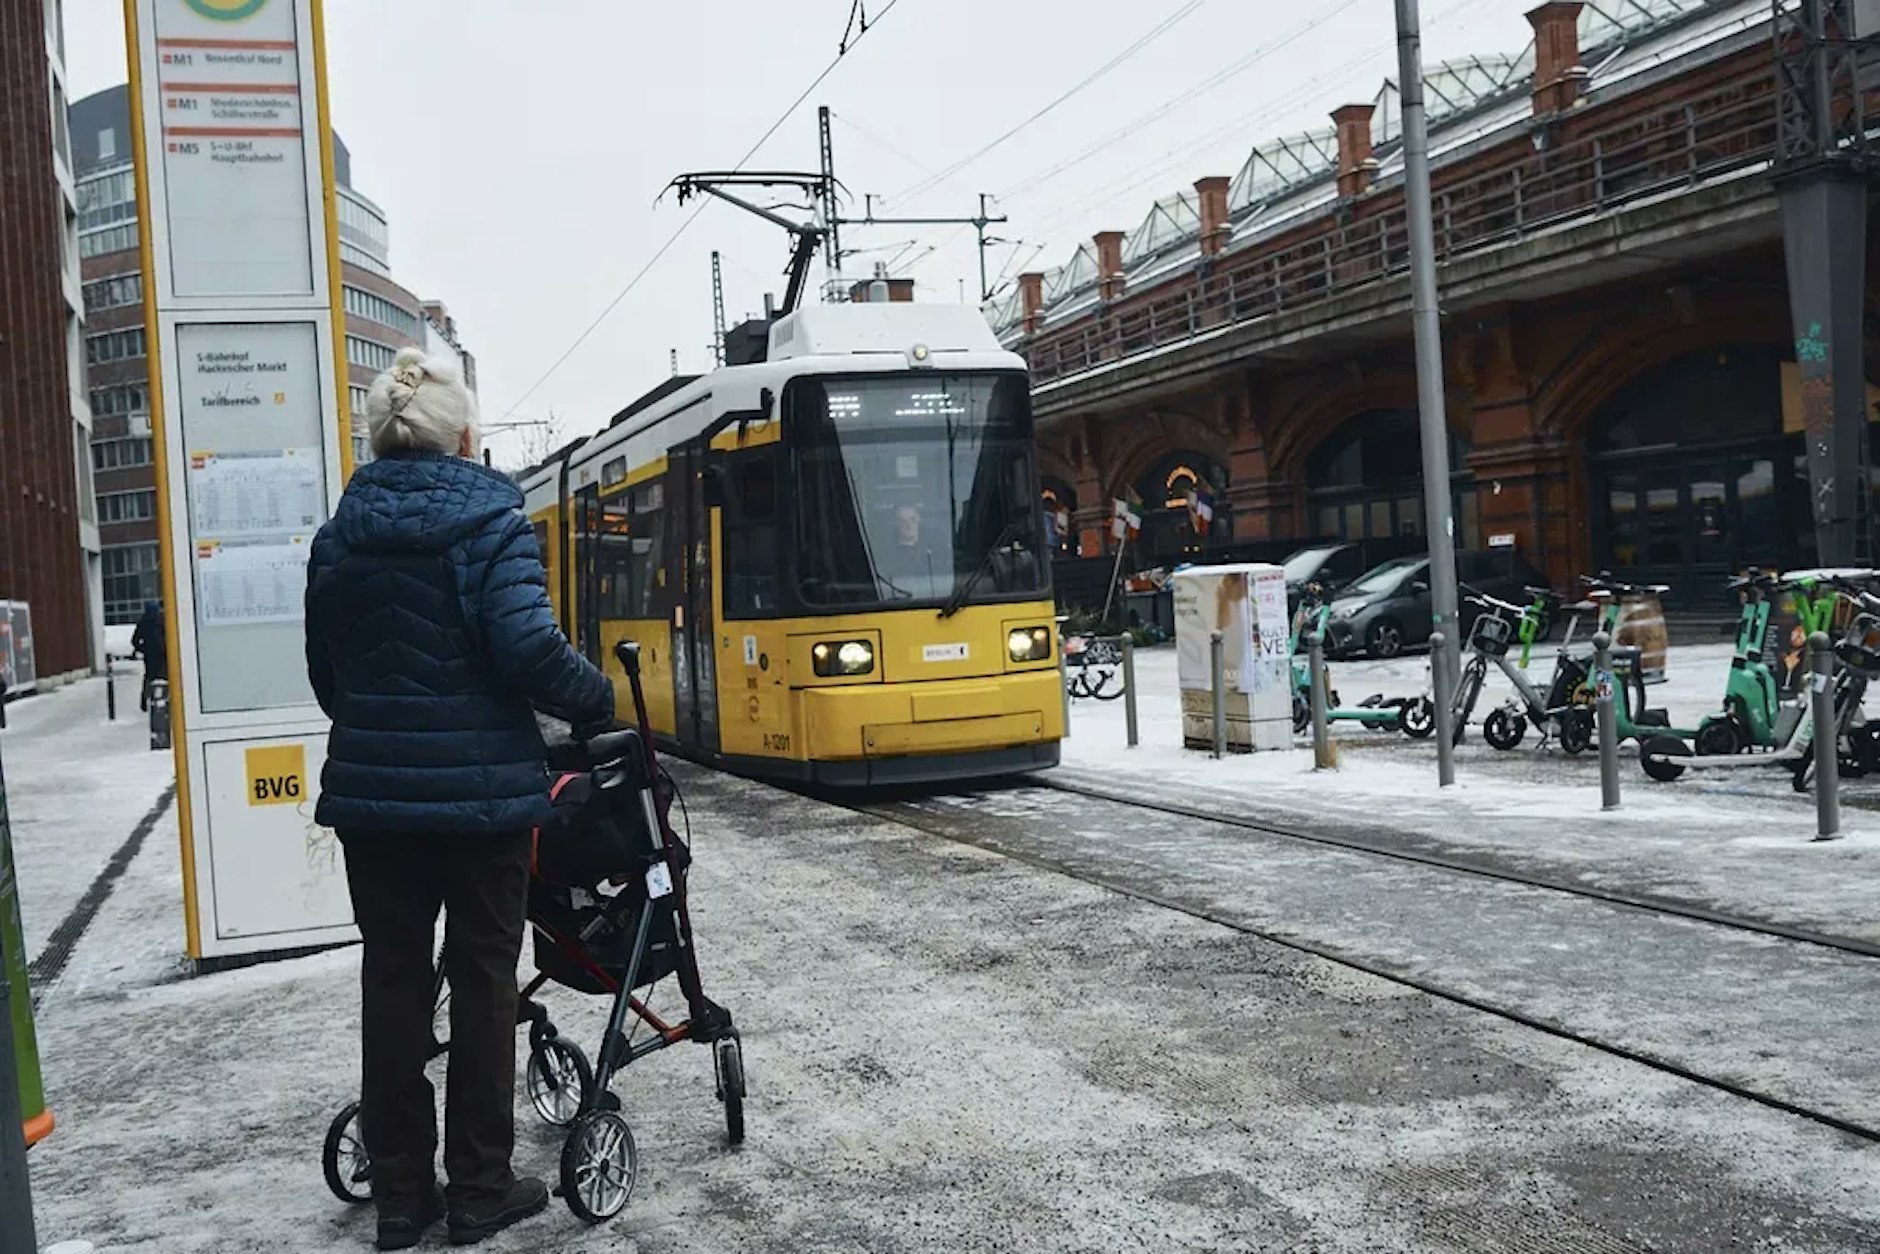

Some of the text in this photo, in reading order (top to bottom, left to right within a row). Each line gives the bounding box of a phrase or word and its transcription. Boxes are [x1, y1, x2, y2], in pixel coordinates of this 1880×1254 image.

[173, 53, 283, 65] M1 Rosenthal Nord
[178, 99, 198, 110] M1
[179, 143, 200, 155] M5
[211, 153, 283, 163] Hauptbahnhof
[197, 351, 249, 362] S-Bahnhof
[198, 363, 287, 374] Hackescher Markt
[201, 396, 261, 407] Tarifbereich
[255, 776, 298, 798] BVG
